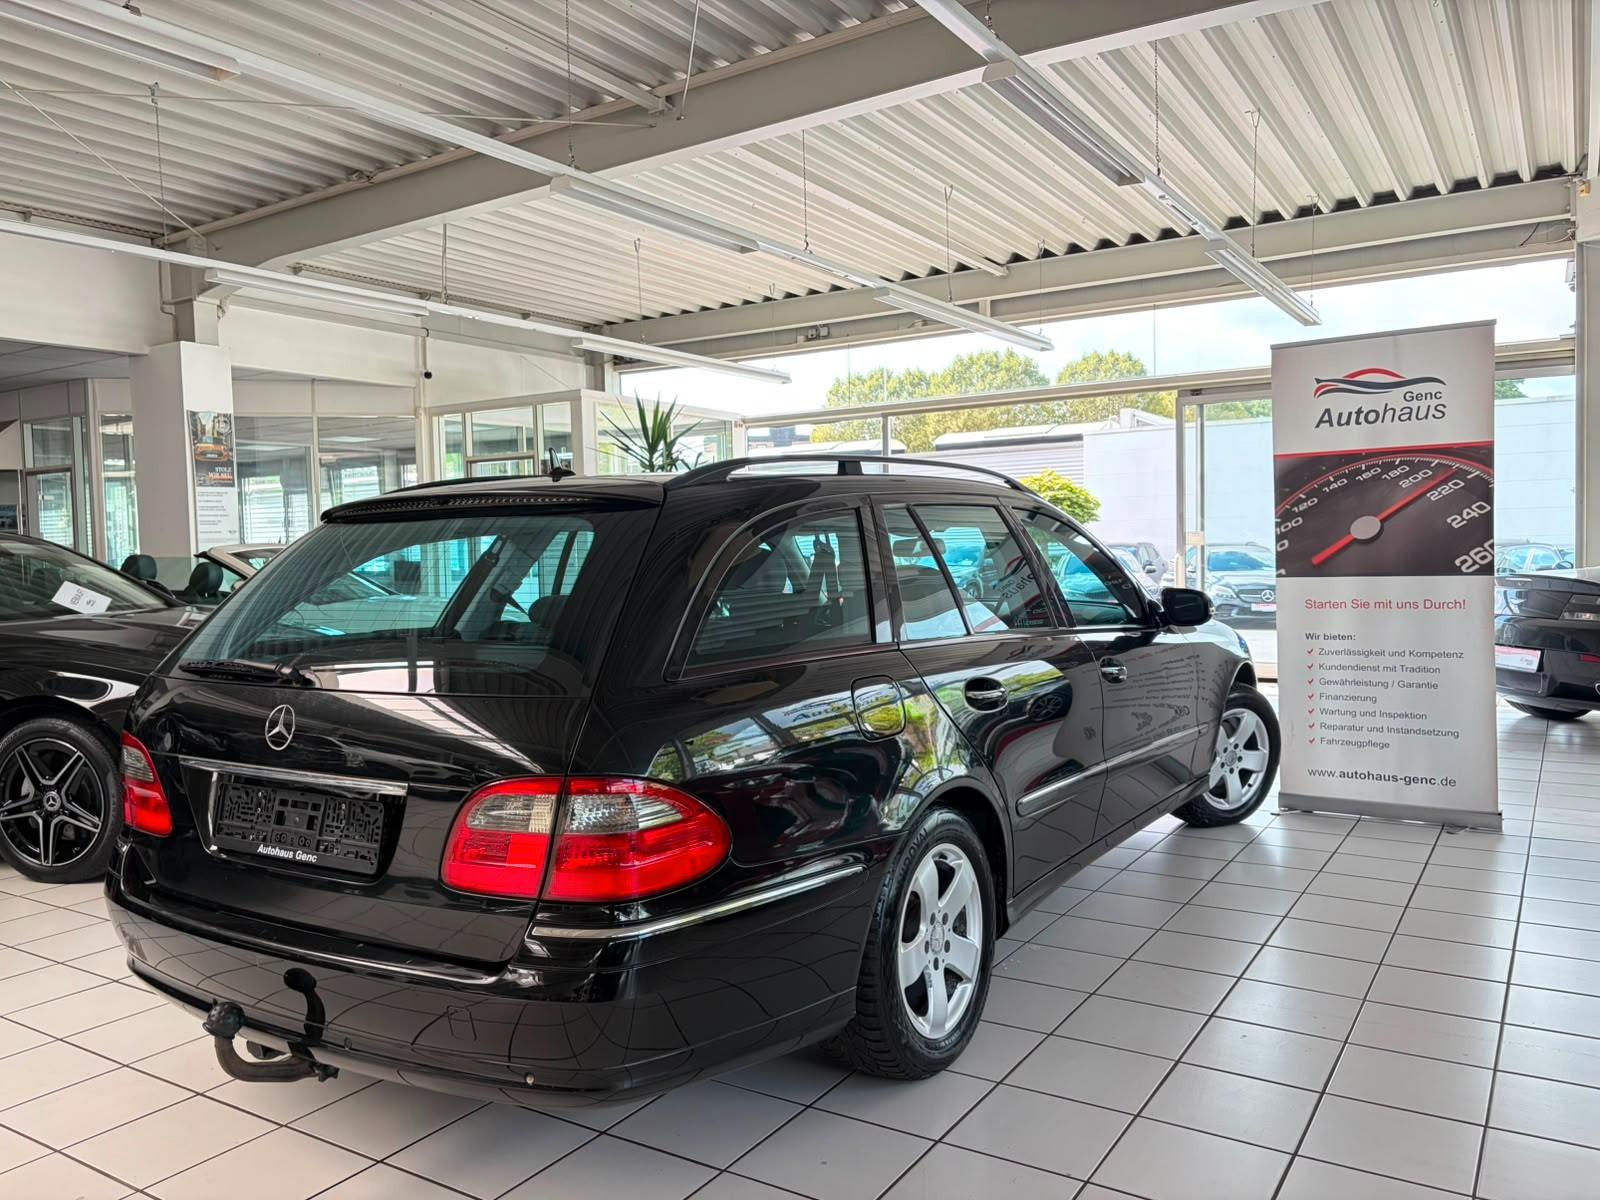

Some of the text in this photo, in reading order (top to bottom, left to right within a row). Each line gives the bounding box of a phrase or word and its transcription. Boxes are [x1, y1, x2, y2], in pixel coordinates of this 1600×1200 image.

[1403, 391, 1442, 402] Genc
[1314, 403, 1447, 429] Autohaus
[1356, 468, 1381, 481] 160
[1381, 466, 1410, 480] 180
[1399, 469, 1432, 488] 200
[1322, 479, 1348, 492] 140
[1427, 479, 1464, 501] 220
[1292, 497, 1318, 513] 120
[1447, 501, 1491, 529] 240
[1305, 599, 1466, 610] Starten Sie mit uns Durch!
[1319, 648, 1464, 660] Zuverlässigkeit und Kompetenz
[1319, 663, 1440, 674] Kundendienst mit Tradition
[1319, 678, 1438, 689] Gewährleistung / Garantie
[1319, 692, 1377, 704] Finanzierung
[1320, 707, 1427, 721] Wartung und Inspektion
[1320, 722, 1459, 739] Reparatur und Instandsetzung
[1320, 737, 1390, 749] Fahrzeugpflege
[1308, 768, 1457, 787] www.autohaus-genc.de
[257, 844, 317, 862] Autohaus Genc
